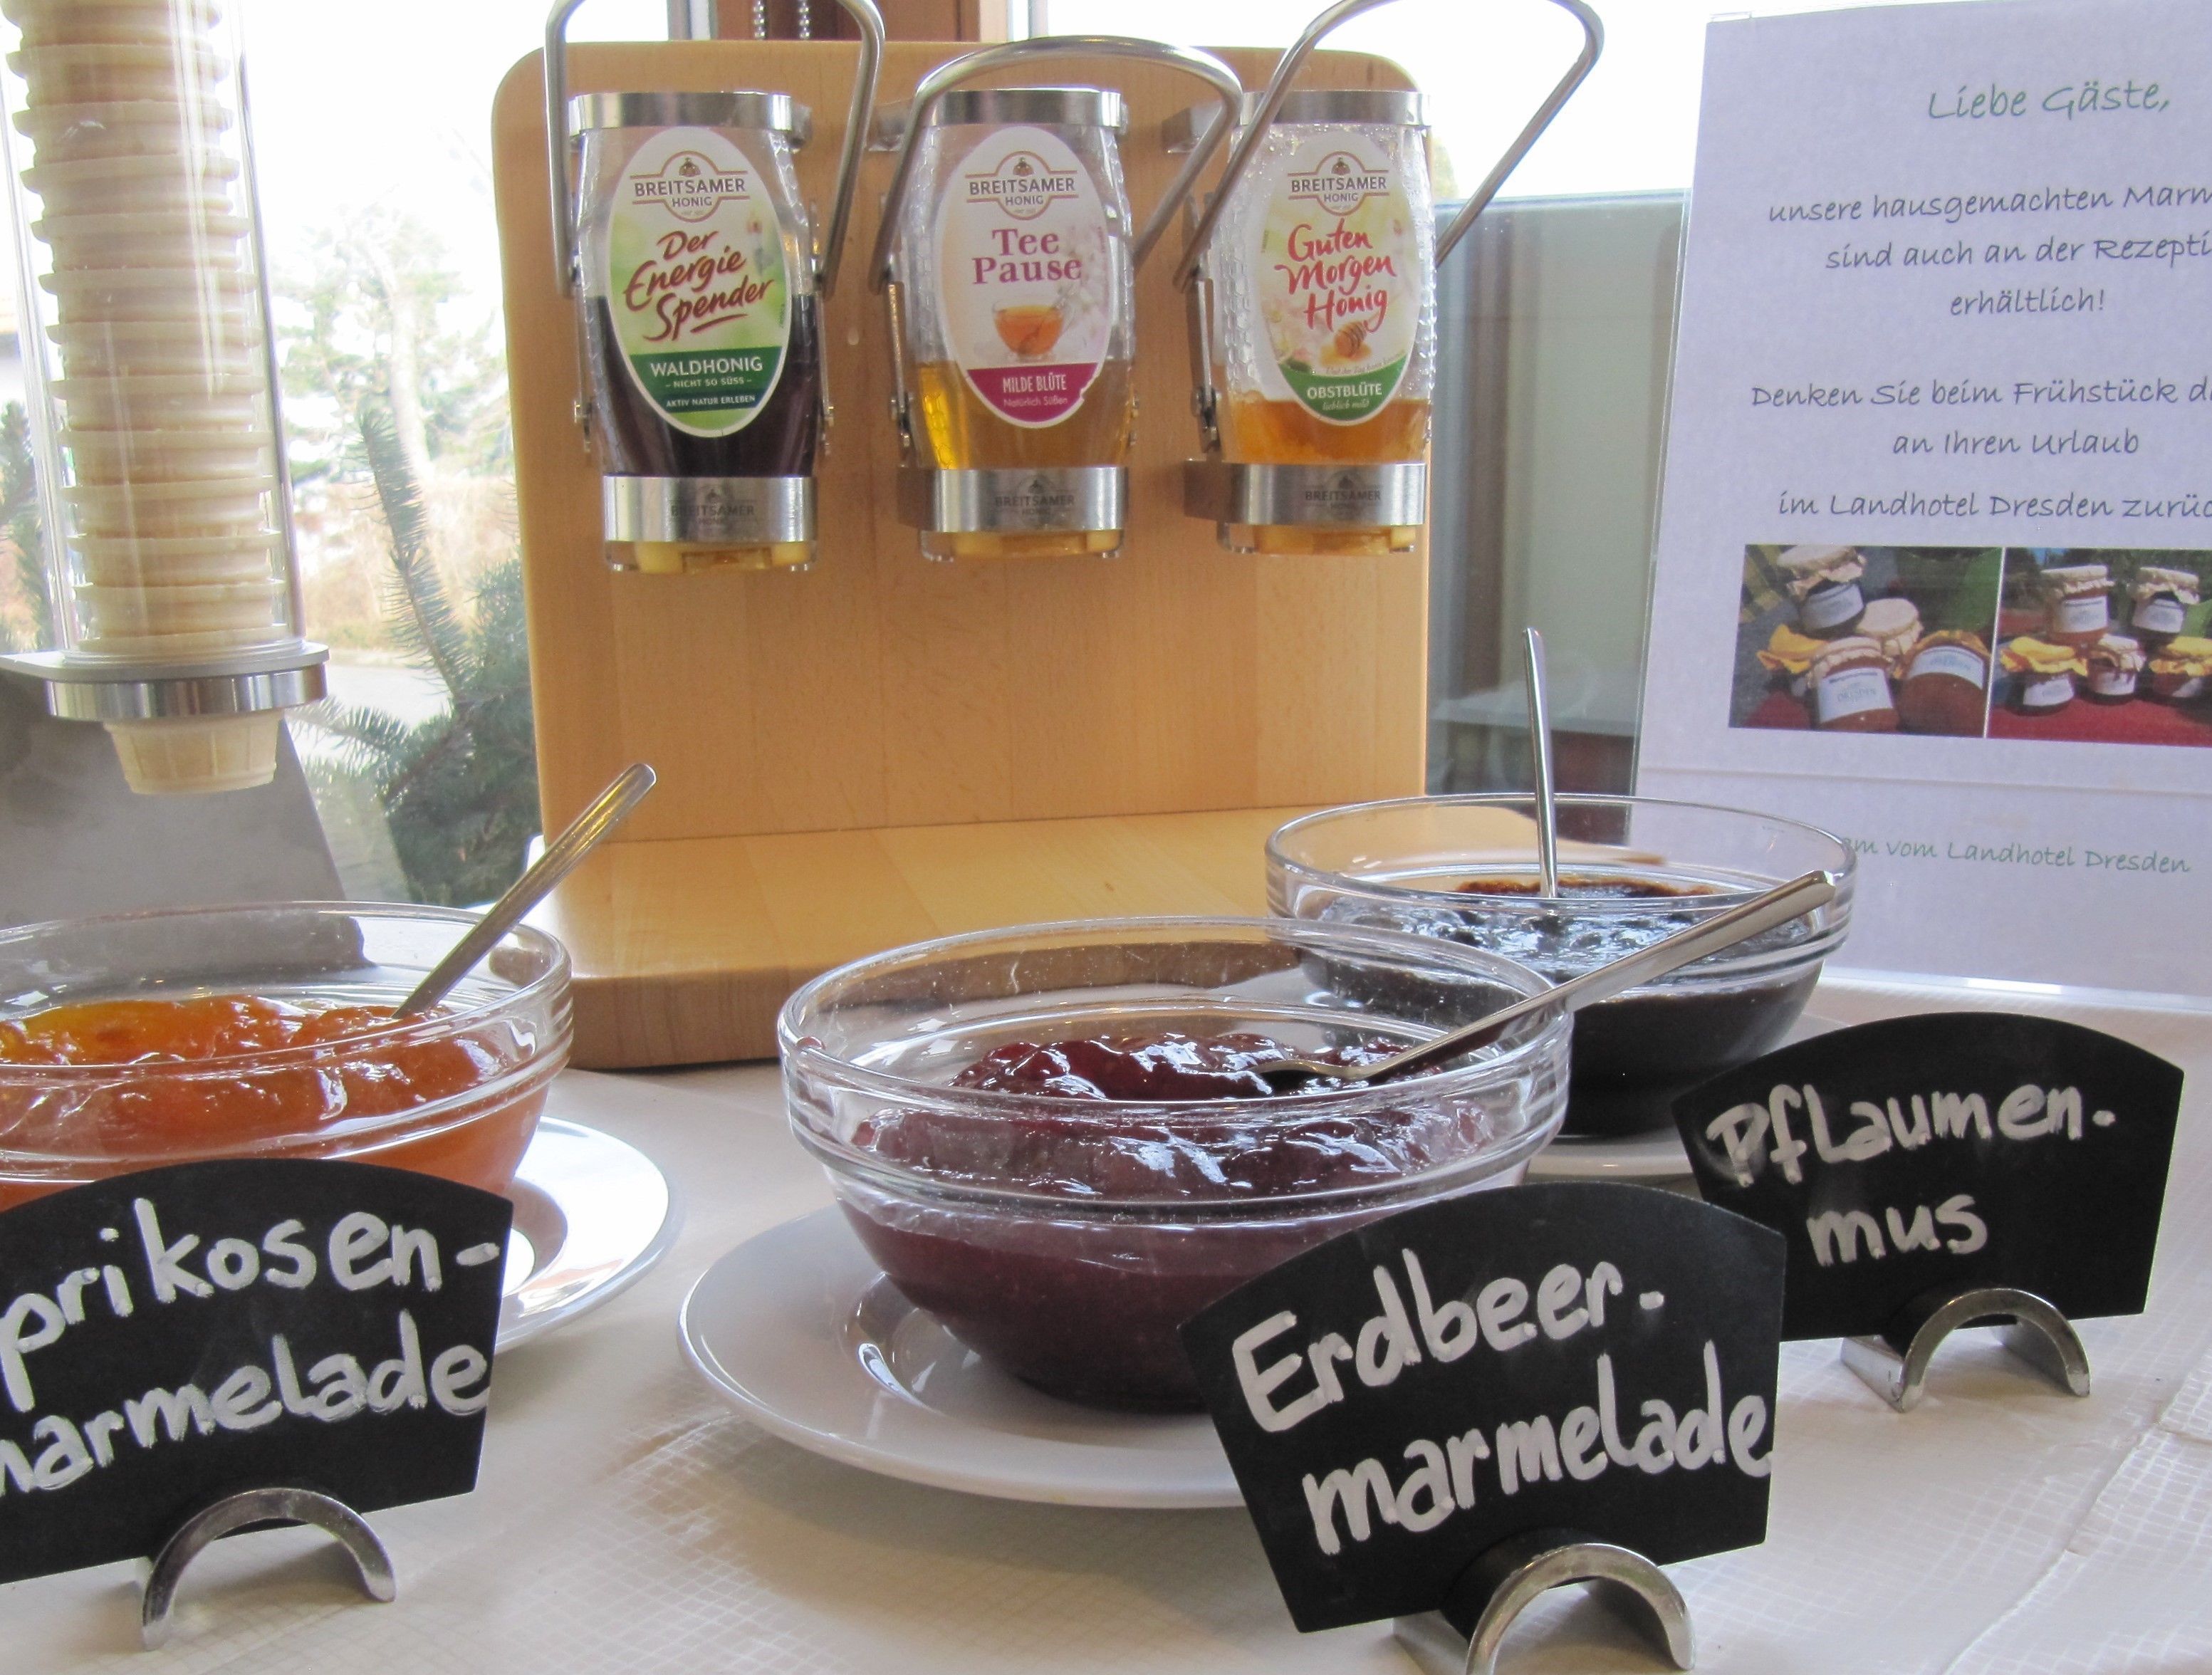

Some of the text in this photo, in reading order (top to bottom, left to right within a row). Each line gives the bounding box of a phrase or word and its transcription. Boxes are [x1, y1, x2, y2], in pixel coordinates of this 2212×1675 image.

[1928, 80, 2170, 120] Liebe Gäste,
[634, 178, 746, 197] BREITSAMER
[969, 178, 1075, 195] BREITSAMER
[1291, 177, 1387, 193] BREITSAMER
[1323, 193, 1359, 203] HONIG
[672, 197, 712, 208] HONIG
[1005, 195, 1044, 206] HONIG
[1768, 199, 1862, 221] unsere
[1873, 187, 2114, 223] hausgemachten
[656, 230, 719, 261] Der
[991, 229, 1060, 256] Tee
[1288, 218, 1373, 262] Guten
[1825, 230, 2212, 269] sind auch an der Rezepti
[623, 246, 747, 312] Energie
[971, 257, 1082, 285] Pause
[1274, 255, 1397, 296] Morgen
[642, 276, 775, 341] Spender
[1303, 285, 1387, 333] Honig
[1950, 286, 2105, 315] erhältlich!
[650, 357, 763, 377] WALDHONIG
[674, 379, 701, 388] NICHT
[705, 378, 717, 387] SO
[721, 377, 745, 386] SÜSS
[1002, 372, 1067, 393] MILDE BLÜTE
[1307, 382, 1382, 400] OBSTBLÜTE
[1751, 382, 1862, 407] Denken
[1871, 380, 1921, 406] Sie
[1932, 380, 2003, 405] beim
[2014, 378, 2179, 405] Frühstück
[666, 395, 756, 408] AKTIV NATUR ERLEBEN
[1894, 428, 2139, 455] an Ihren Urlaub
[996, 495, 1075, 508] BREITSAMER
[1305, 490, 1382, 501] BREITSAMER
[1780, 491, 1820, 515] im
[1830, 491, 1979, 516] Landhotel
[1990, 492, 2114, 517] Dresden
[671, 505, 755, 518] BREITSAMER
[1887, 840, 1937, 857] vom
[1947, 842, 2077, 868] Landhotel
[2085, 850, 2191, 874] Dresden
[1806, 1194, 1988, 1267] mus
[1302, 1340, 1774, 1555] marmelade
